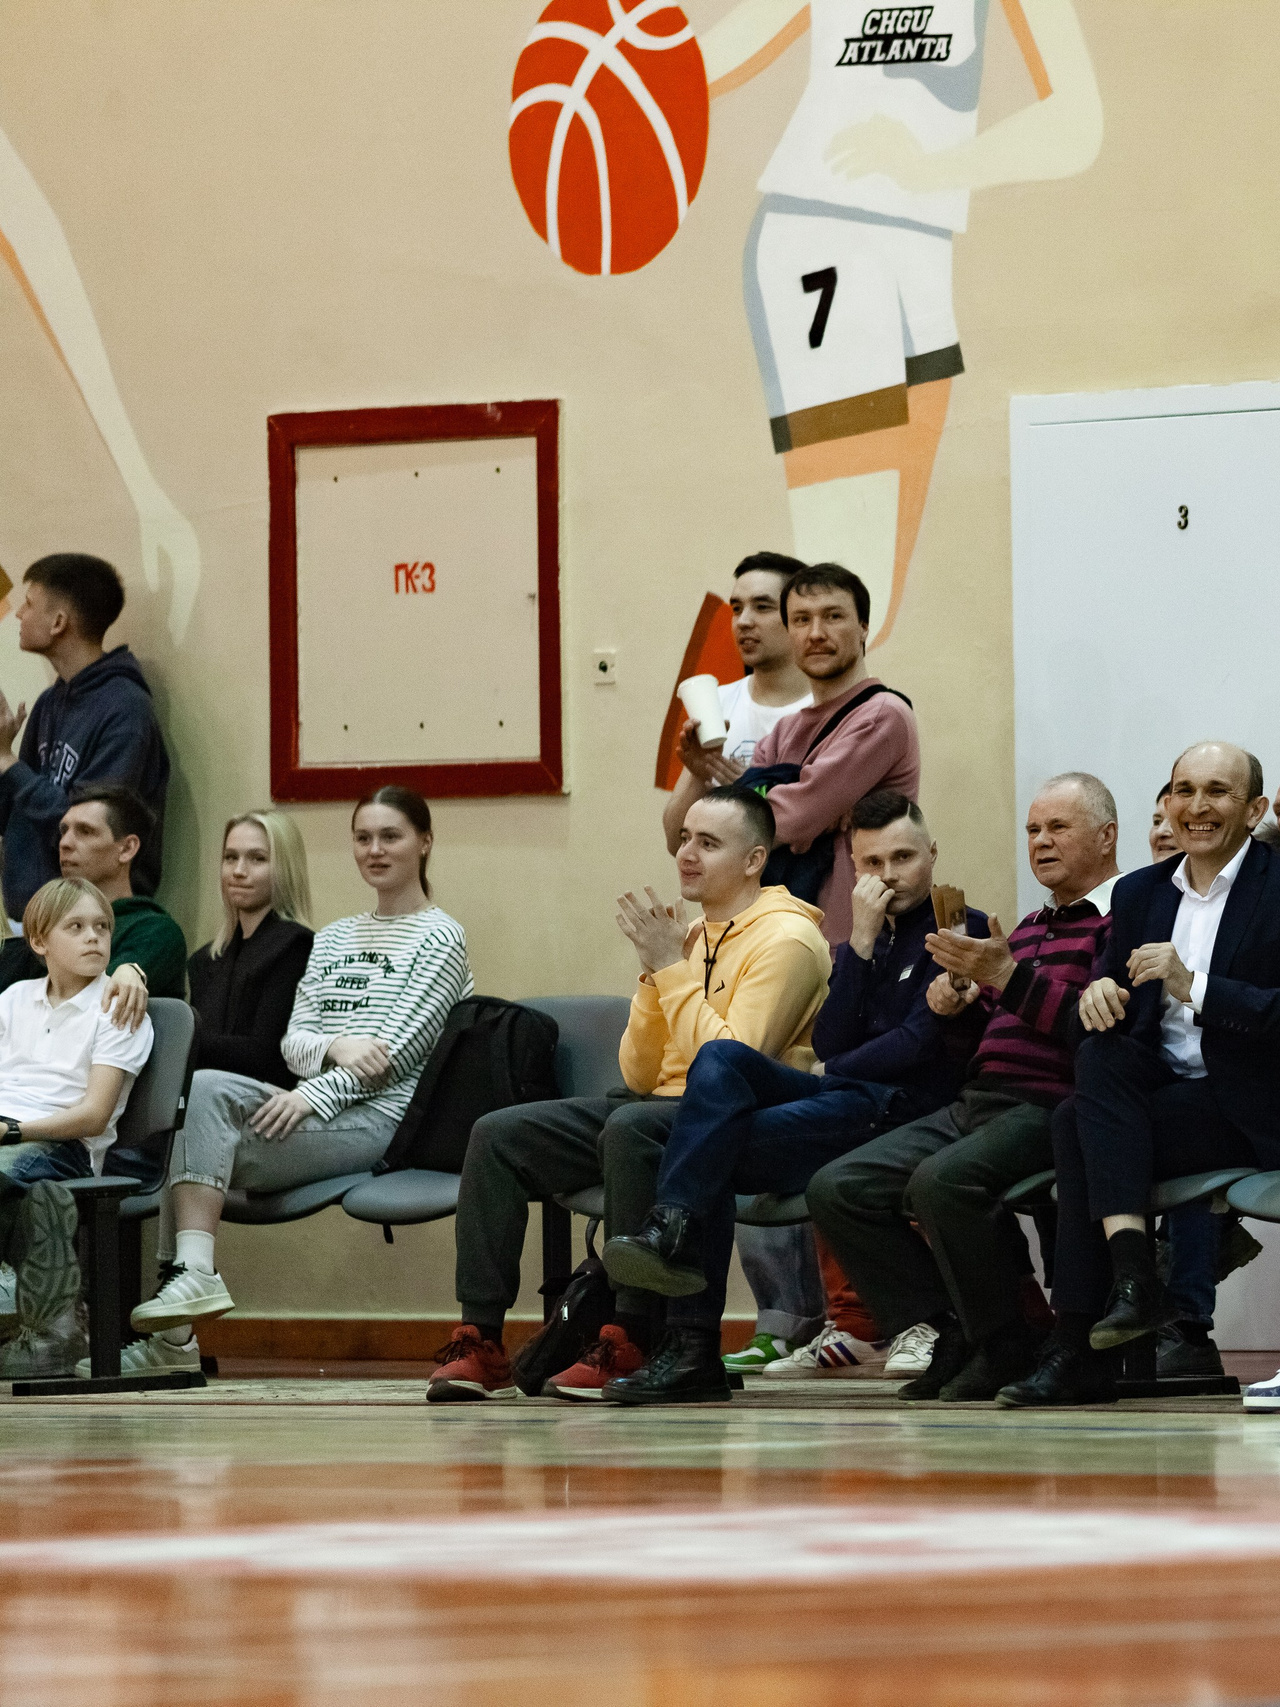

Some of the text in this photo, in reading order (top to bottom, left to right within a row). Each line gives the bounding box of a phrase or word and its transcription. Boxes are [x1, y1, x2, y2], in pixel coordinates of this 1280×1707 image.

[862, 8, 932, 35] CHGU
[840, 36, 950, 64] ATLANTA
[801, 266, 838, 349] 7
[1177, 505, 1188, 530] 3
[394, 561, 436, 594] ПК-3
[335, 976, 370, 990] OFFER
